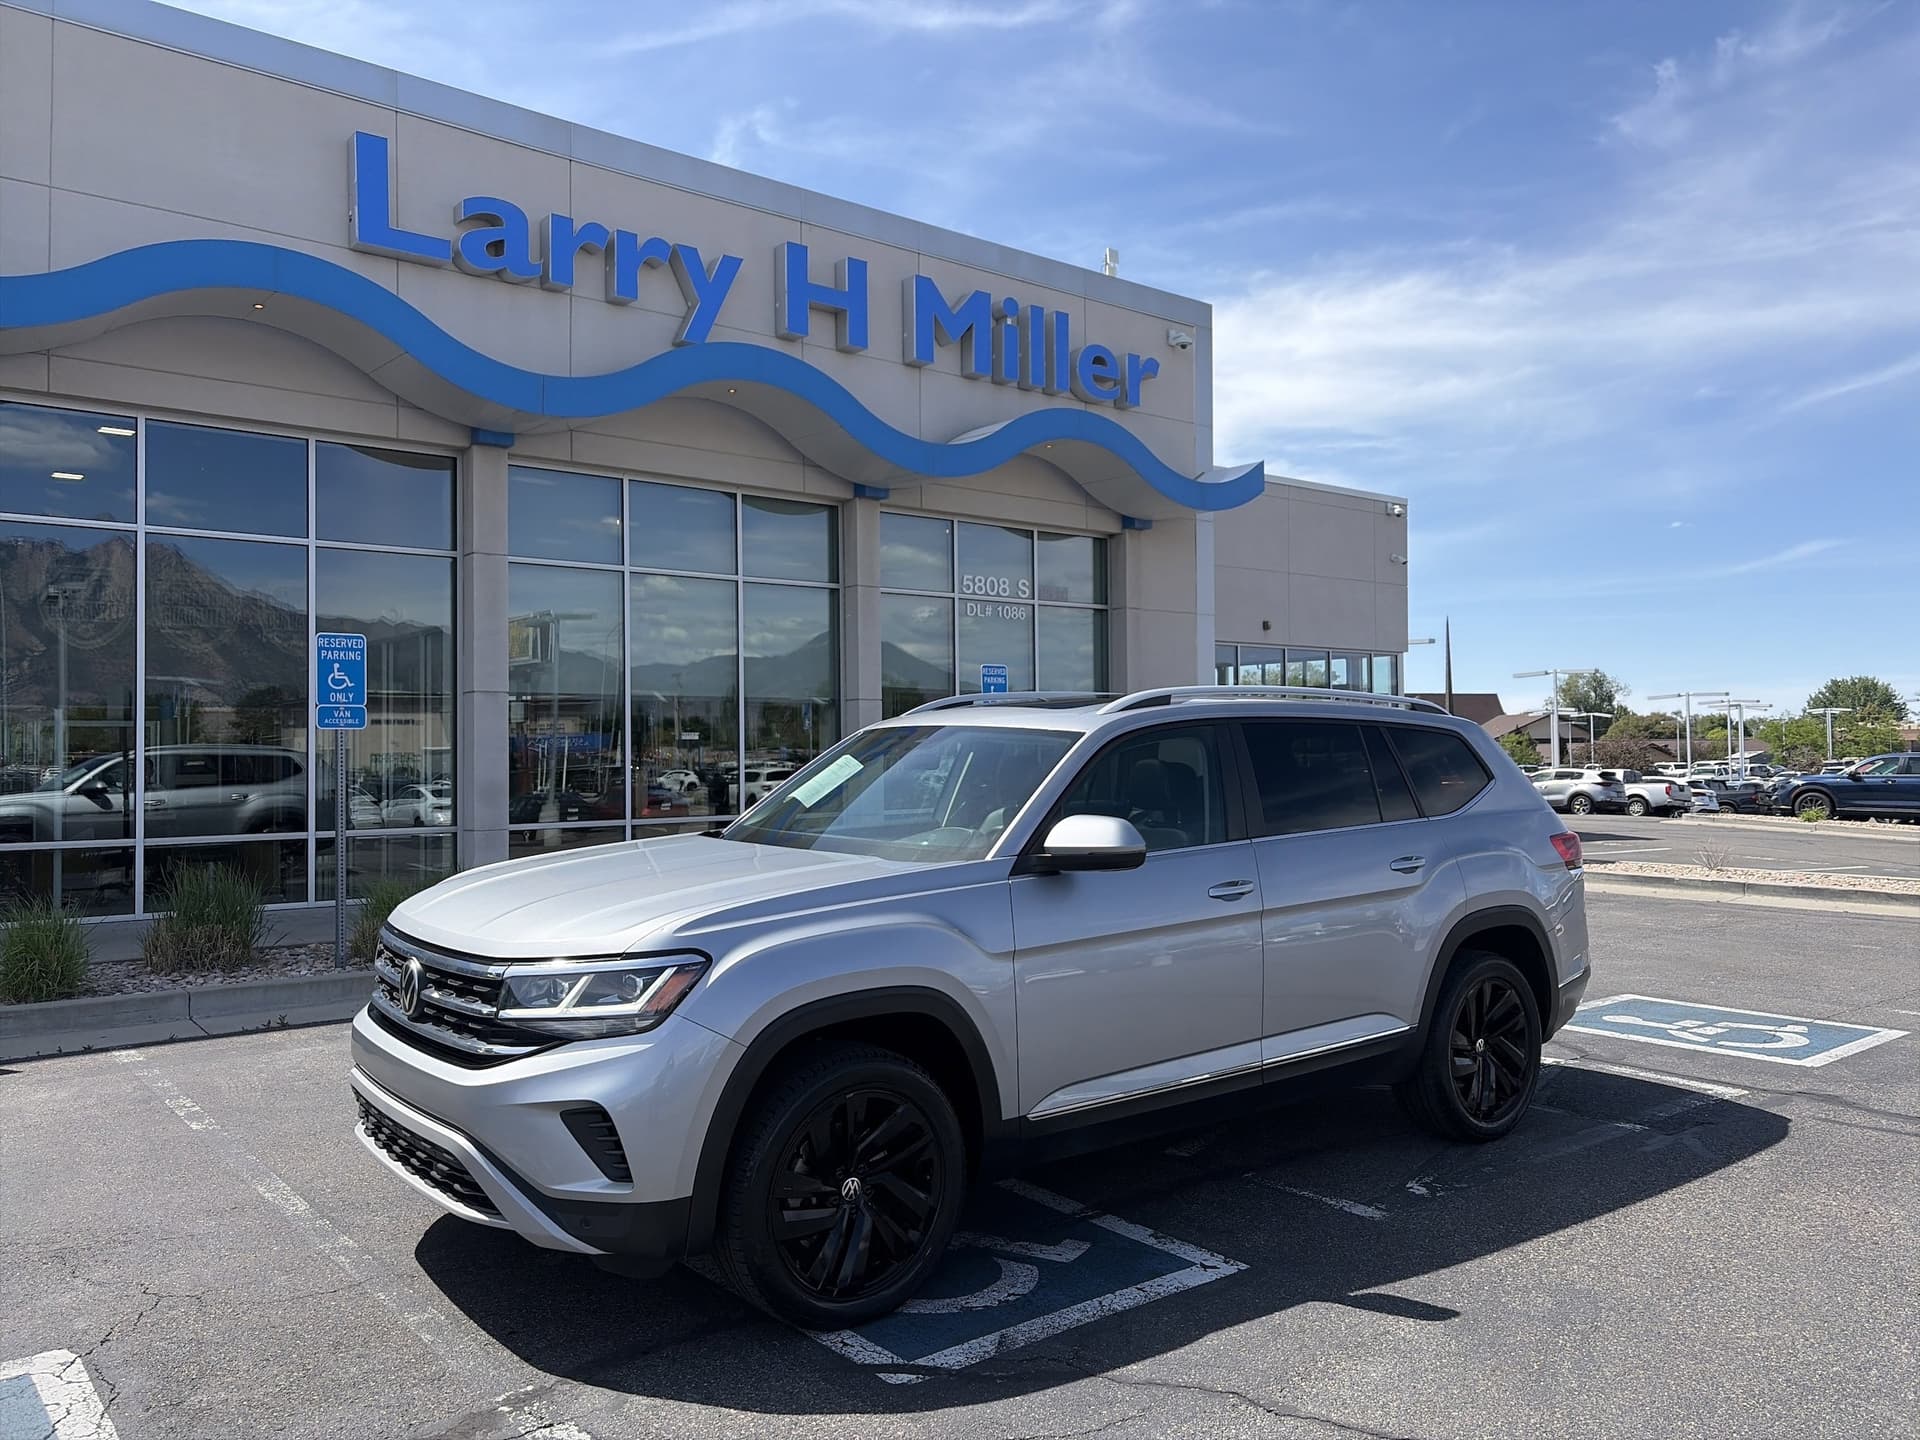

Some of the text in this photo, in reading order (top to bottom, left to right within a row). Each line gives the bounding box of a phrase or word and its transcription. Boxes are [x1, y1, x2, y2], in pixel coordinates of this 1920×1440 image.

[350, 131, 1160, 408] Larry H Miller
[962, 575, 1030, 598] 5808 S
[966, 602, 1026, 621] DL# 1086
[318, 637, 364, 649] RESERVED
[321, 650, 361, 661] PARKING
[329, 692, 354, 702] ONLY
[333, 710, 351, 718] VAN
